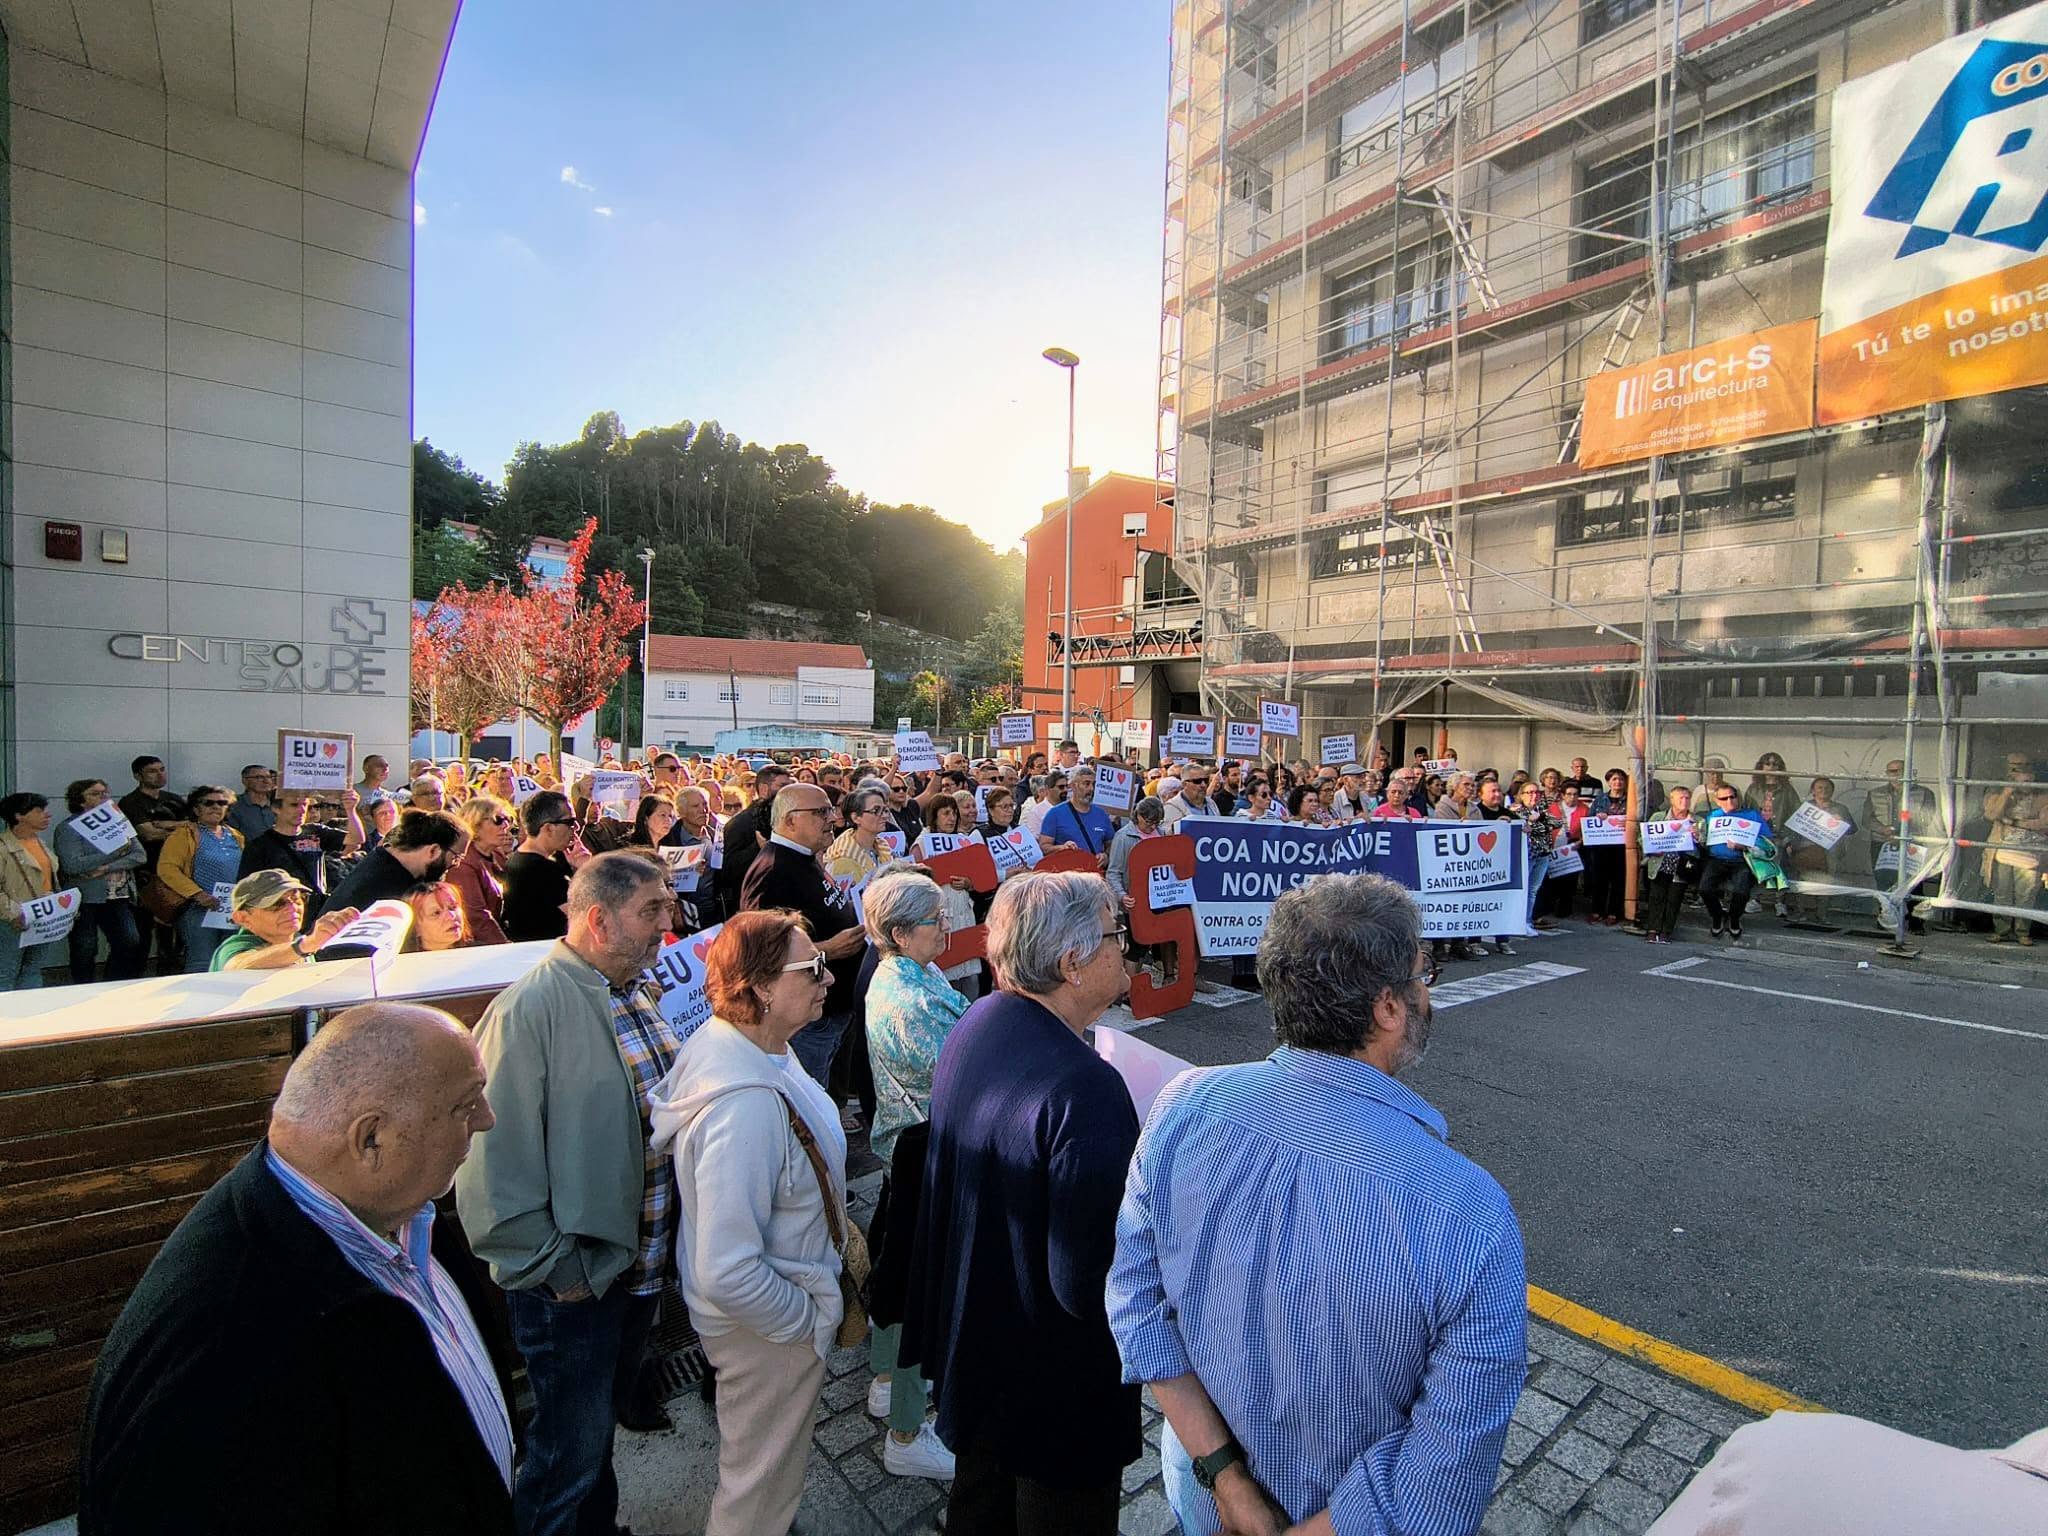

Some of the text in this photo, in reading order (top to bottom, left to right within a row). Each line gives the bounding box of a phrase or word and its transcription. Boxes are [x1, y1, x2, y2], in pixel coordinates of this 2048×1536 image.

[1852, 332, 1889, 362] Tú
[1900, 322, 1931, 345] te
[1944, 308, 1976, 330] lo
[1652, 344, 1771, 393] arc+s
[1651, 375, 1768, 411] arquitectura
[48, 527, 78, 536] FUEGO
[108, 633, 386, 671] CENTRO DE
[240, 662, 386, 694] SAÚDE
[1266, 704, 1279, 715] EU
[1128, 721, 1138, 731] EU
[1177, 722, 1192, 733] EU
[1232, 724, 1245, 736] EU
[294, 740, 317, 758] EU
[1426, 761, 1438, 769] EU
[1100, 768, 1114, 783] EU
[519, 779, 536, 792] EU
[81, 808, 112, 831] EU
[1804, 807, 1823, 820] EU
[1587, 819, 1603, 828] EU
[1647, 824, 1665, 834] EU
[1715, 818, 1731, 828] EU
[932, 837, 953, 852] EU
[990, 838, 1008, 854] EU
[1195, 828, 1391, 865] COA NOSA SAÚDE
[1434, 833, 1470, 857] EU
[667, 850, 685, 865] EU
[1444, 857, 1492, 873] ATENCIÓN
[1152, 866, 1169, 881] EU
[1427, 870, 1507, 889] SANITARIA DIGNA
[1221, 872, 1283, 897] NON
[31, 900, 54, 919] EU
[1419, 901, 1503, 913] NIDADE PÚBLICA!
[1201, 915, 1262, 927] ONTRA OS
[1421, 919, 1490, 931] ÚDE DE SEIXO
[1210, 936, 1260, 948] PLATAFO
[651, 951, 692, 994] EU
[688, 985, 706, 1002] APA
[672, 1003, 704, 1027] PÚBLICO
